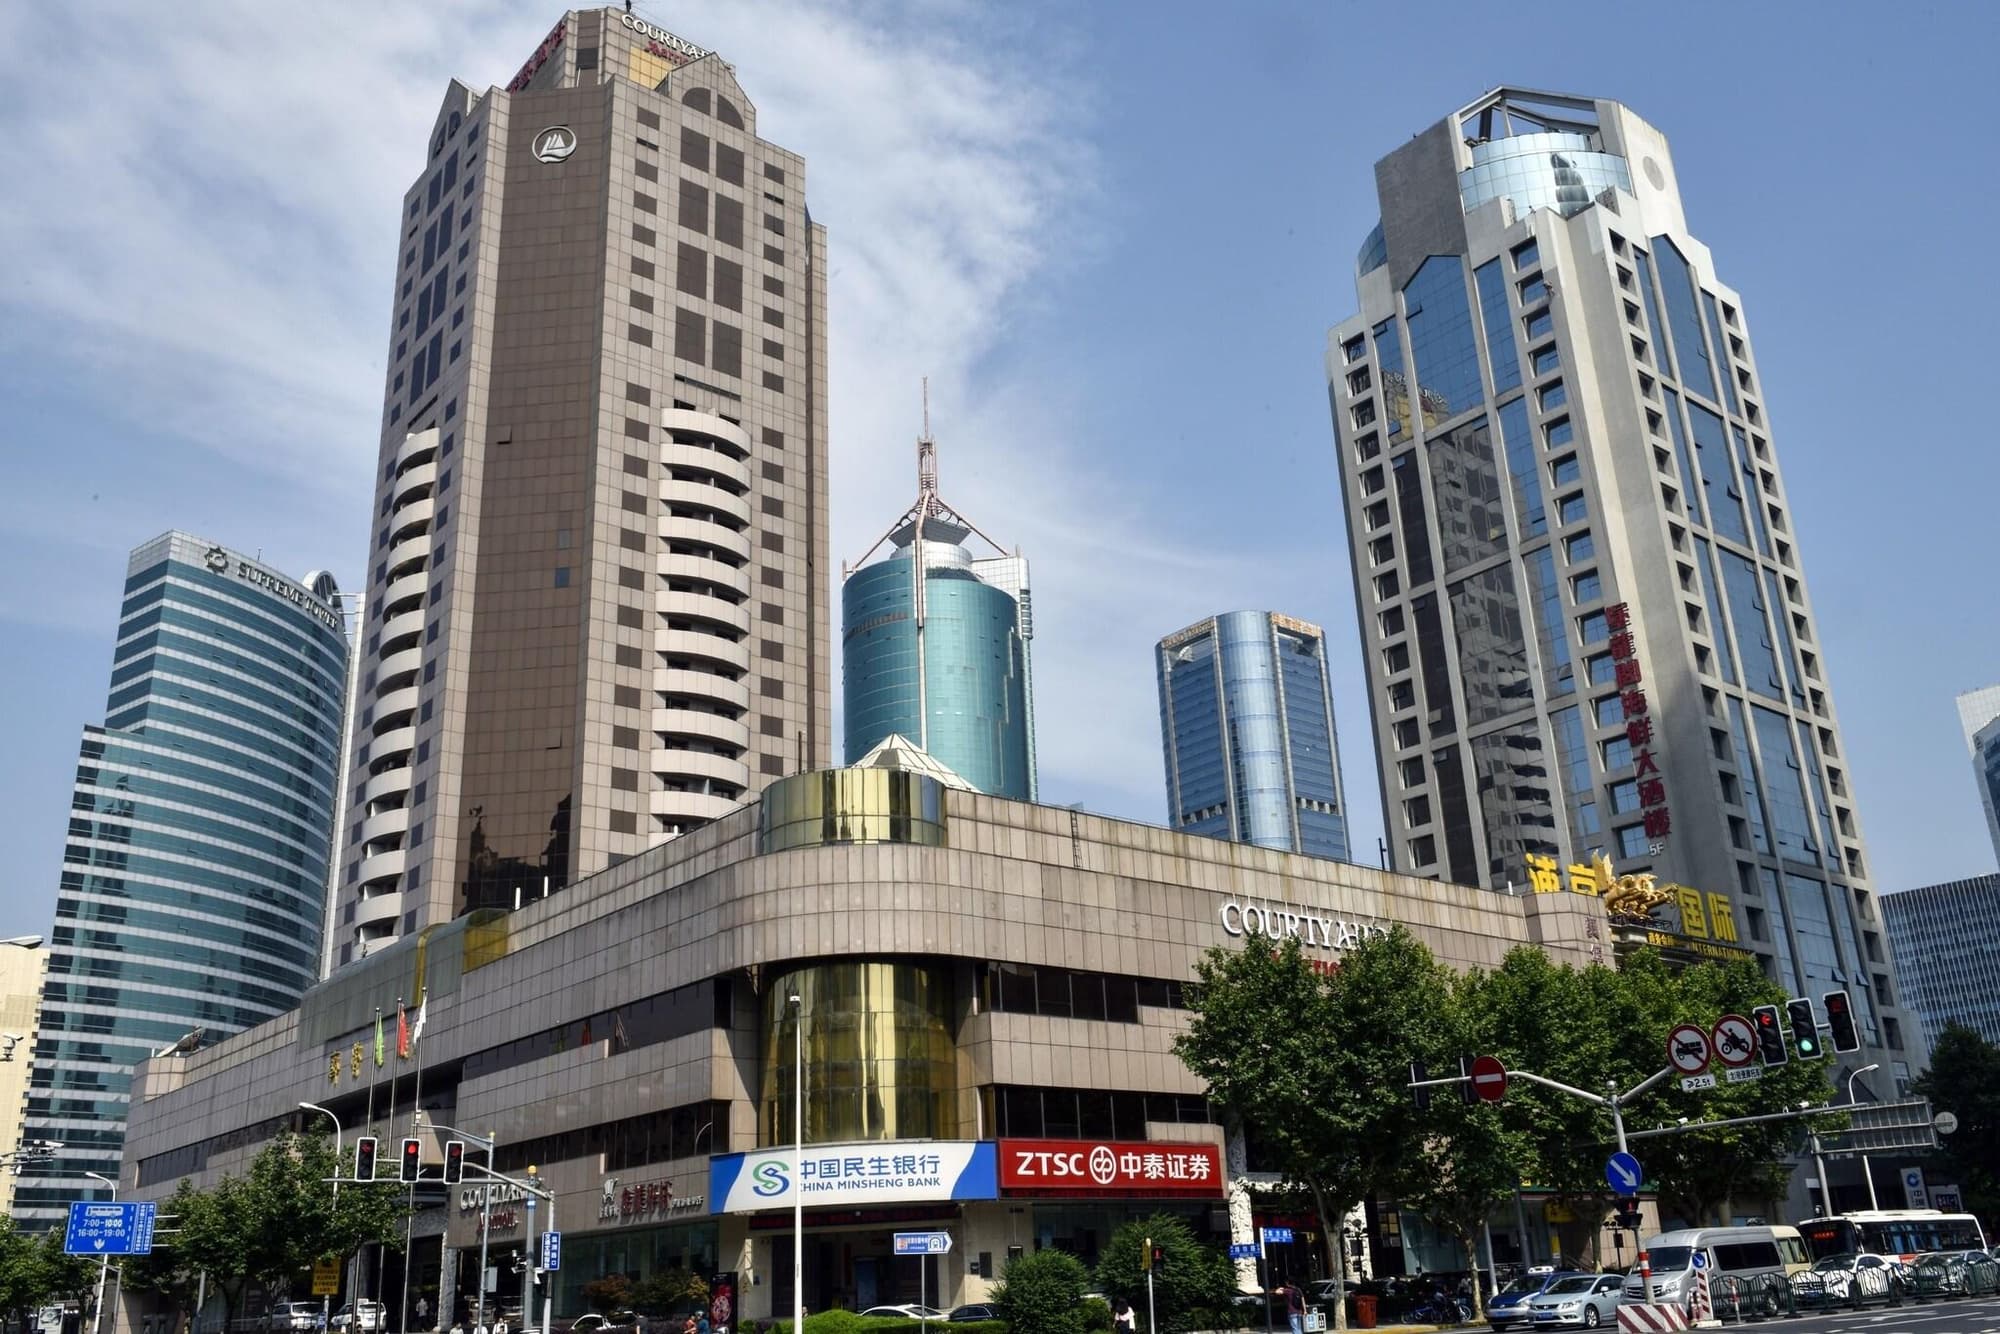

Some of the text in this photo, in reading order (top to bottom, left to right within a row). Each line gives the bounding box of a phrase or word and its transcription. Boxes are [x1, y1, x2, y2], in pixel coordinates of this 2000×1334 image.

[237, 562, 304, 607] SUPREME
[1649, 843, 1664, 856] 5F
[801, 1154, 941, 1180] 中国民生银行
[1016, 1152, 1211, 1180] ZTSC 中泰证券
[837, 1178, 904, 1191] MINSHENG
[907, 1176, 941, 1188] BANK
